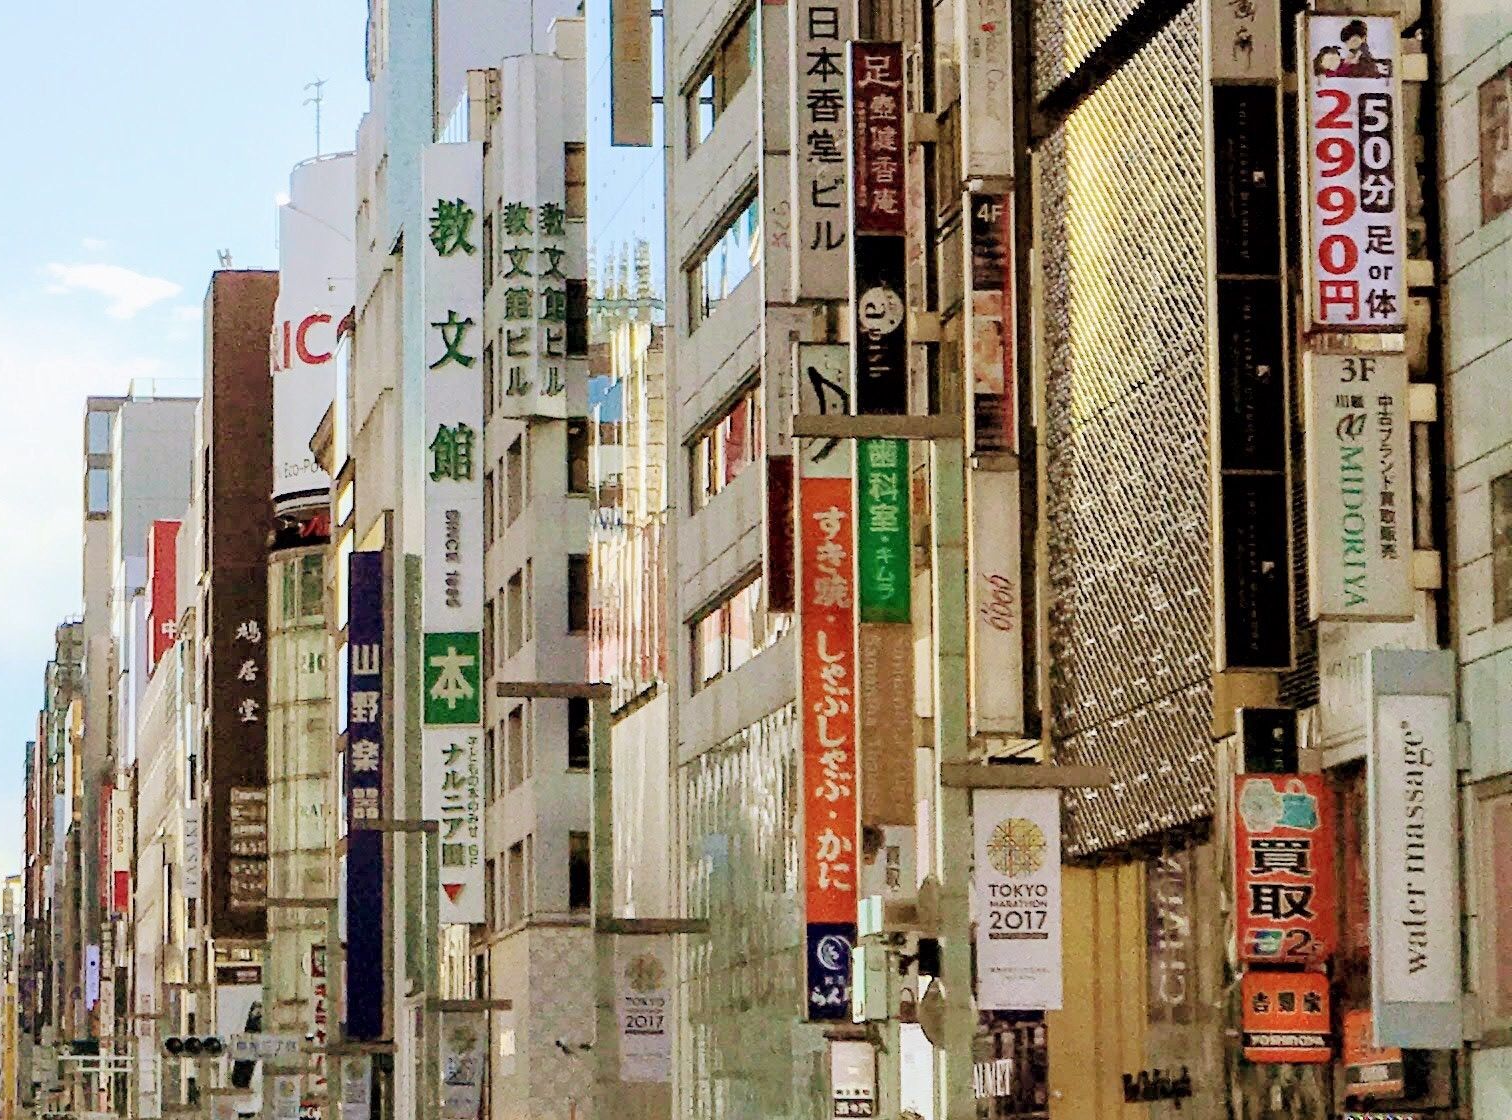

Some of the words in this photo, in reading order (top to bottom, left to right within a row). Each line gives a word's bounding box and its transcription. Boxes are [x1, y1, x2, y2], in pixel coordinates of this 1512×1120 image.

[806, 7, 846, 250] 日本香堂ビル
[1361, 99, 1395, 205] 50分
[976, 203, 1003, 223] 4F
[1315, 89, 1360, 321] 2990円
[1365, 225, 1395, 255] 足
[504, 202, 534, 396] 教文館ビル
[538, 202, 566, 397] 教文館ビル
[1365, 289, 1396, 318] 体
[1369, 266, 1392, 280] or
[429, 198, 477, 482] 教文館
[1339, 358, 1376, 382] 3F
[1339, 447, 1368, 607] MIDORIYA
[430, 646, 475, 709] 本
[351, 644, 380, 819] 山野楽器
[441, 743, 466, 867] ナルニア国
[988, 884, 1048, 897] TOKYO
[989, 911, 1047, 929] 2017
[990, 900, 1047, 908] MARATHON
[1250, 839, 1315, 920] 買取
[1403, 883, 1429, 975] water
[626, 1015, 664, 1028] 2017
